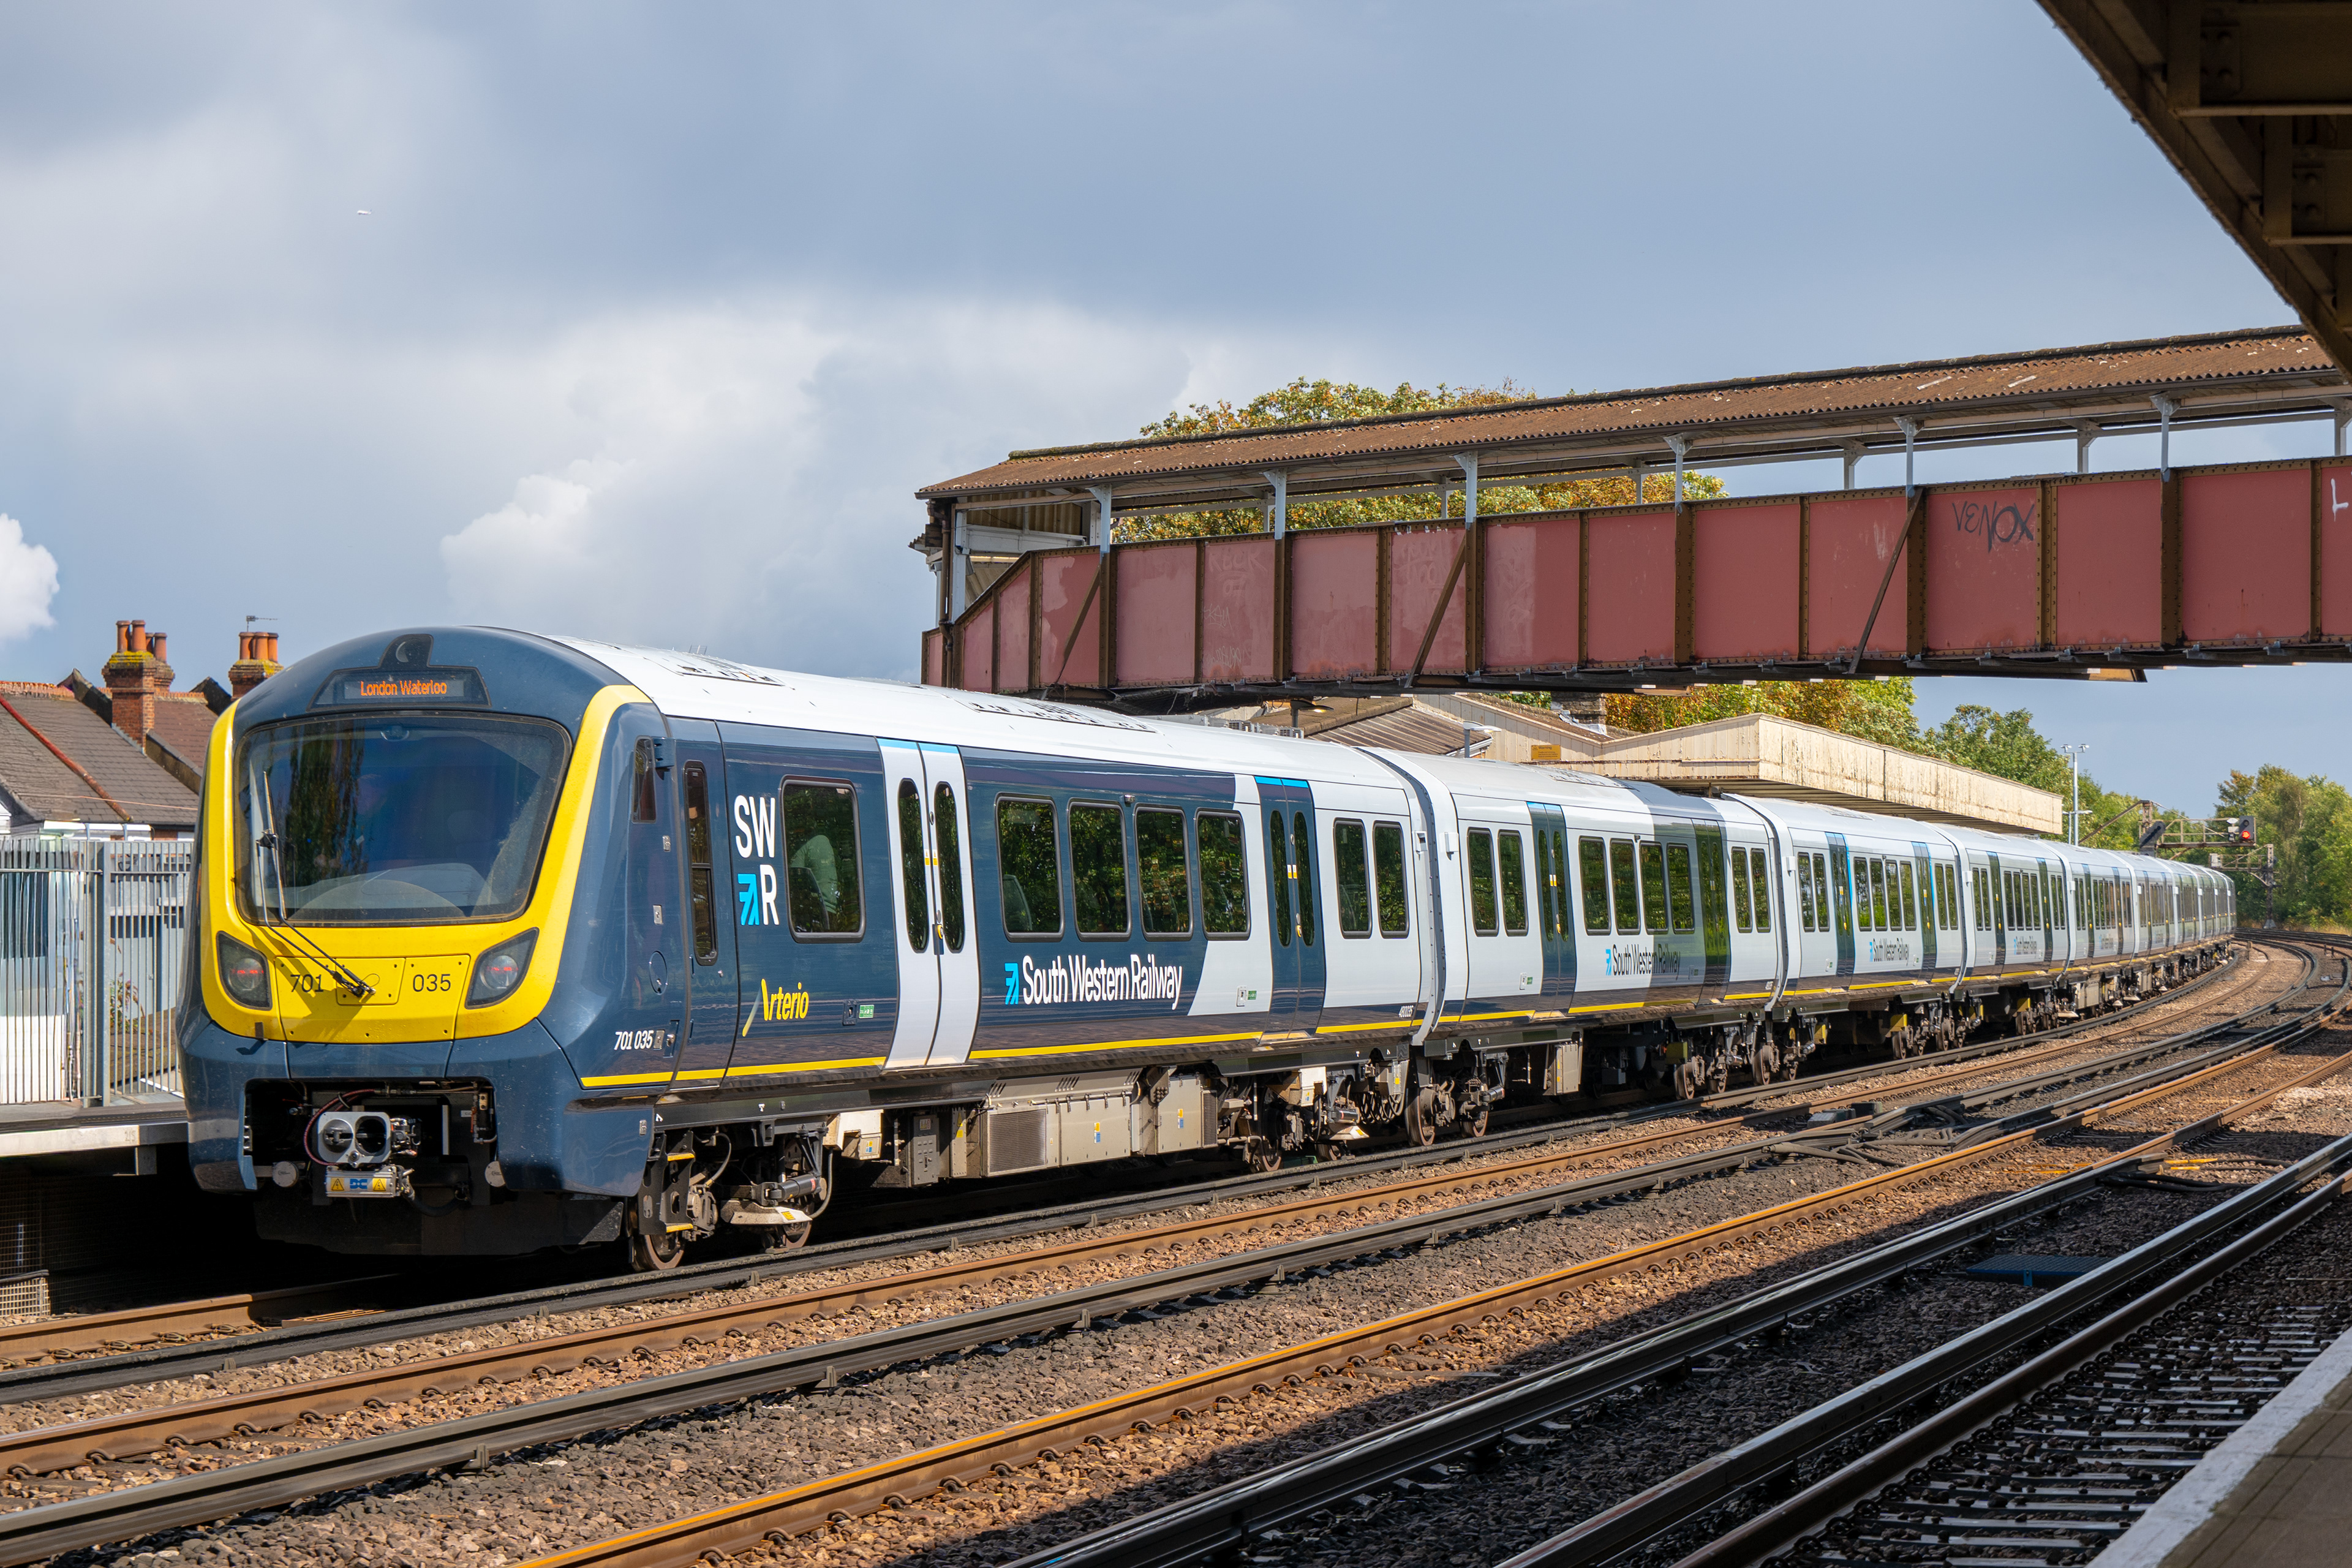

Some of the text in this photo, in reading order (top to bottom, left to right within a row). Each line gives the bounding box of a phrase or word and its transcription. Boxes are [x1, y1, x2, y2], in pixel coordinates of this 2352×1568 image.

[360, 679, 447, 696] London Waterloo
[734, 795, 776, 858] SW
[760, 864, 780, 925] R
[290, 973, 451, 993] 701 035
[1022, 954, 1183, 1011] South Western Railway
[1613, 943, 1681, 981] South Western Railway
[742, 978, 809, 1037] Arterio
[614, 1030, 654, 1050] 701 035
